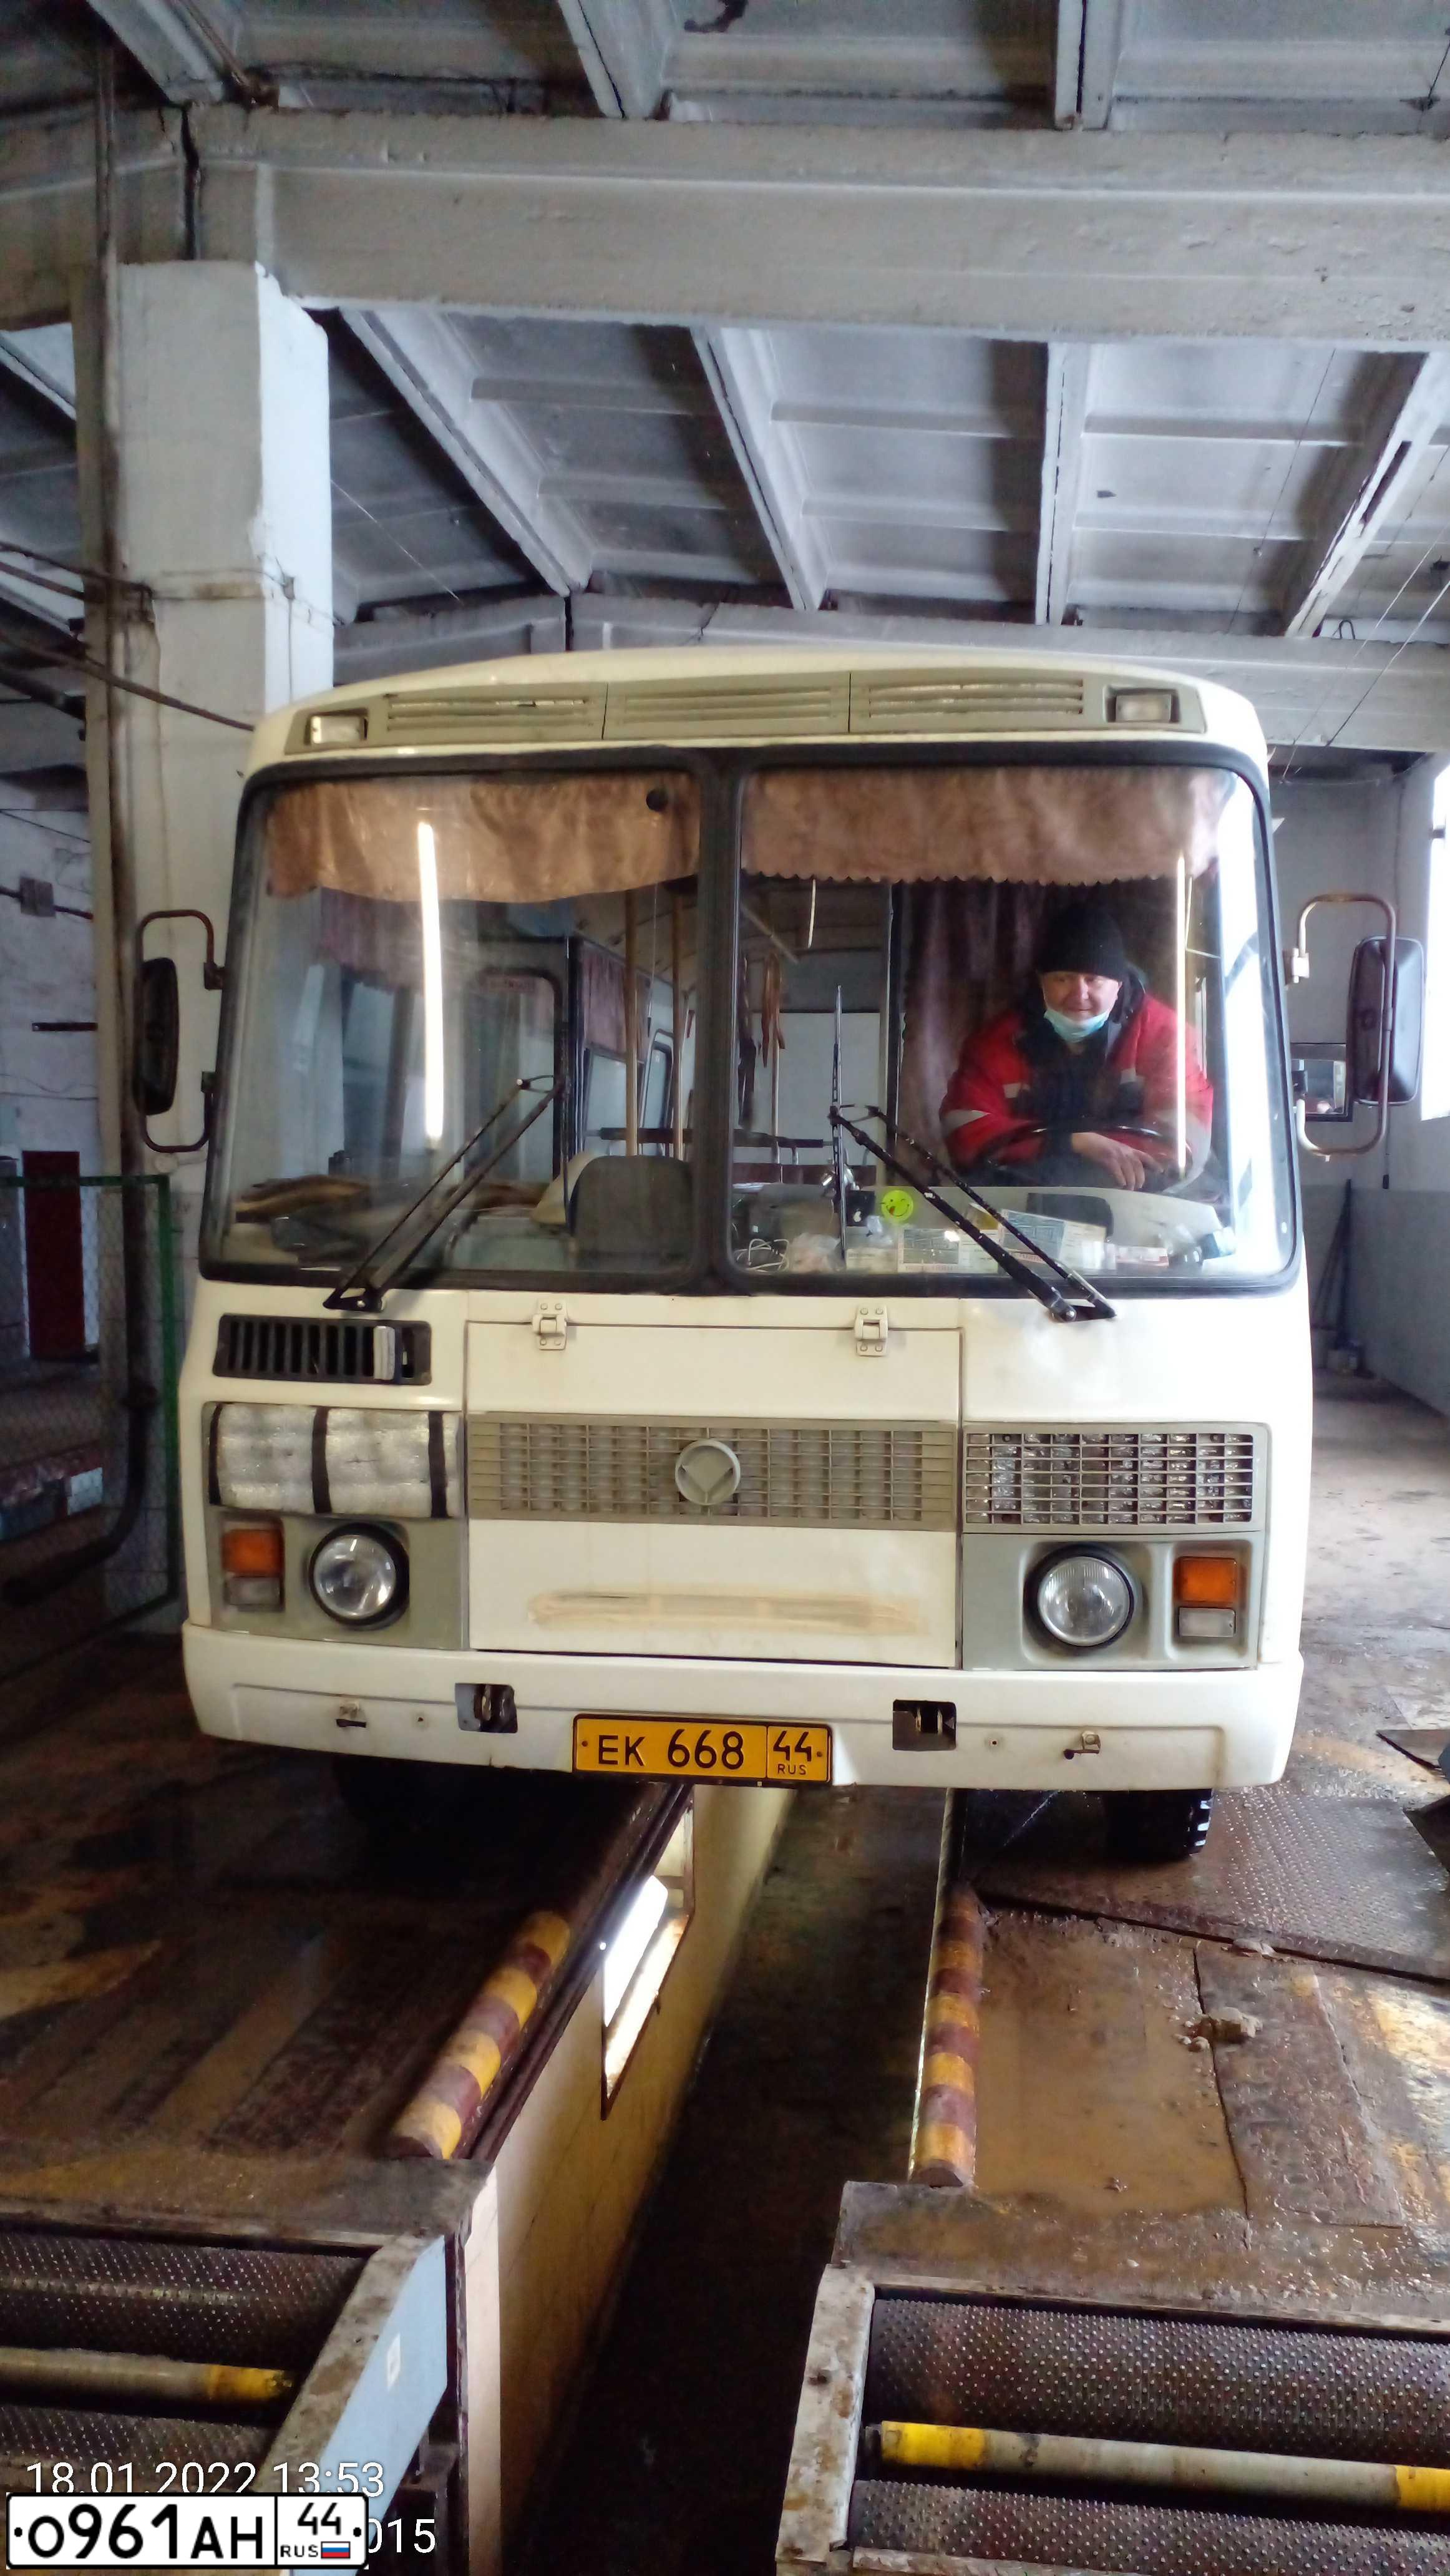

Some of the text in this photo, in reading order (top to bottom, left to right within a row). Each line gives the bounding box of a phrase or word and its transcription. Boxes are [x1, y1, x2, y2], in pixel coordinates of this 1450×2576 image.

[667, 1729, 744, 1770] 668
[772, 1730, 812, 1762] 44
[777, 1764, 807, 1775] RUS
